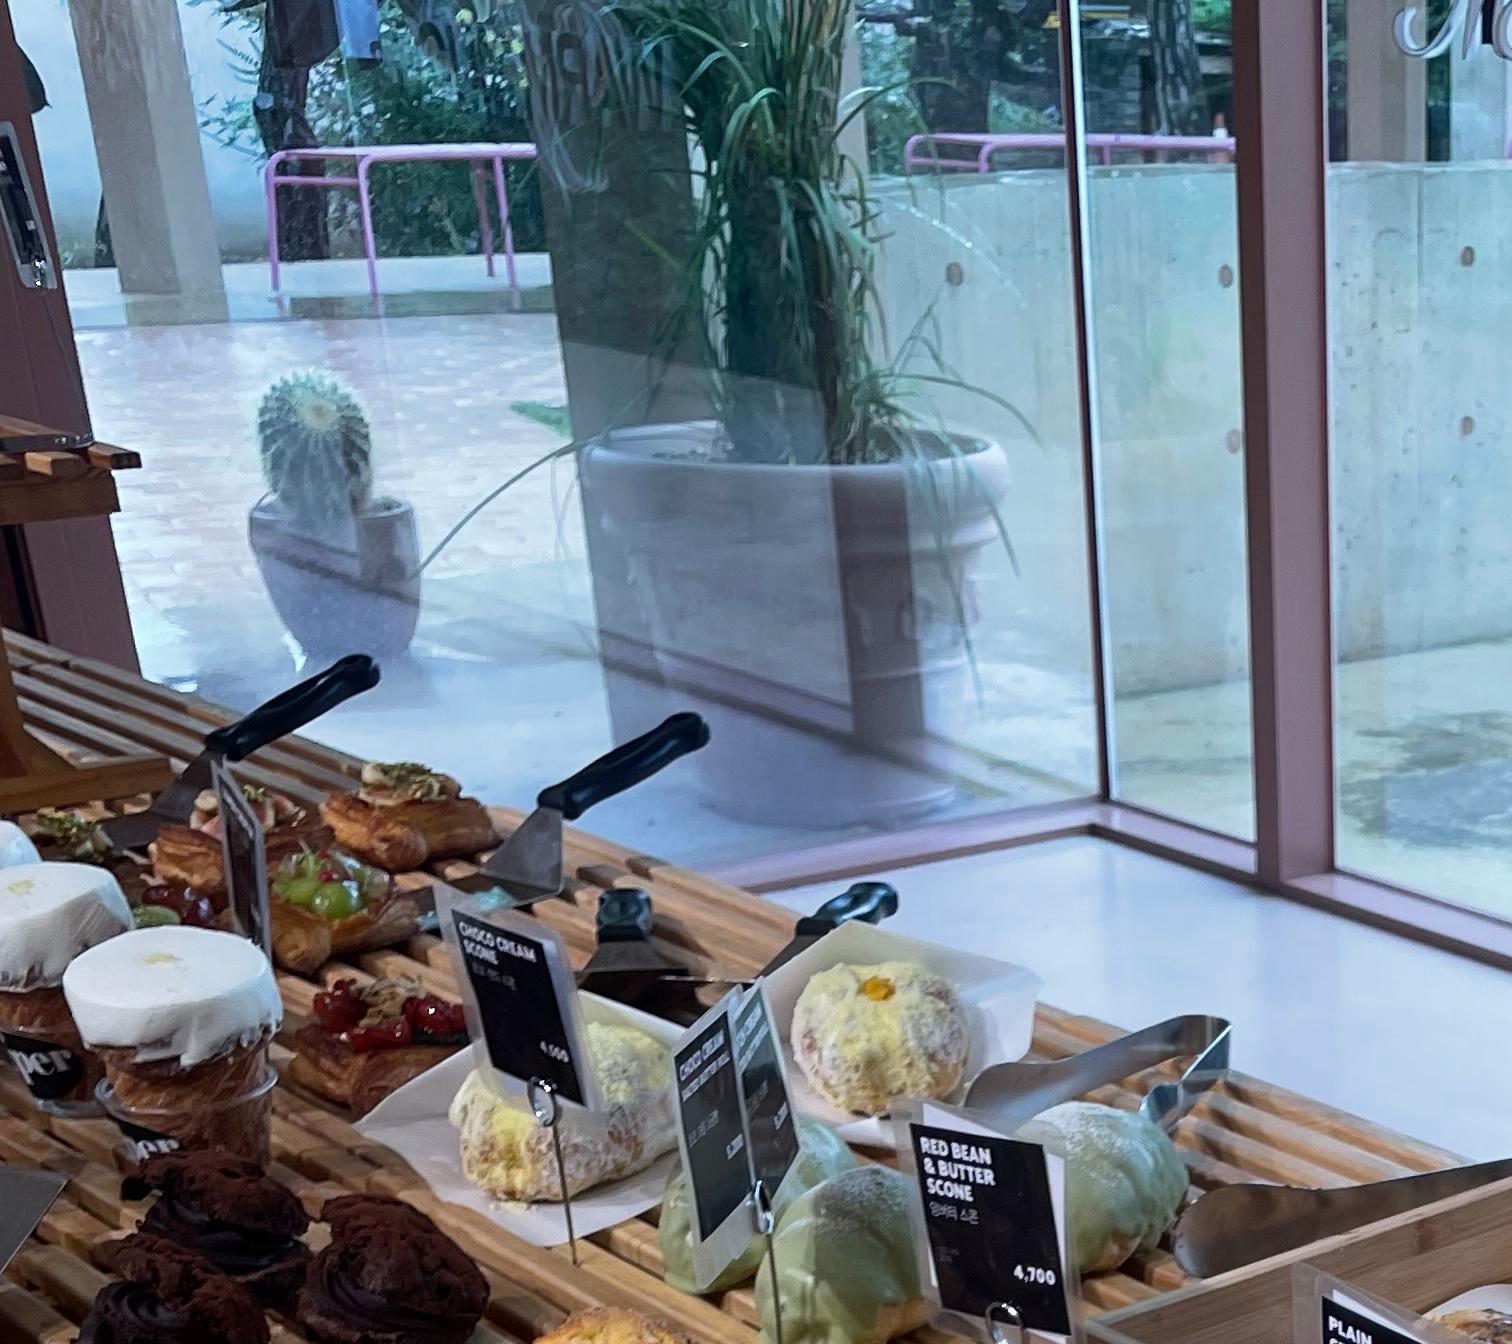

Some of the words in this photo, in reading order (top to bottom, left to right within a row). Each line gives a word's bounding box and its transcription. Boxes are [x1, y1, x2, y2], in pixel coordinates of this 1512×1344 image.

[920, 1136, 949, 1156] RED
[951, 1142, 992, 1165] BEAN
[923, 1157, 936, 1175] &
[937, 1160, 996, 1186] BUTTER
[926, 1177, 974, 1202] SCONE
[1013, 1264, 1056, 1286] 4,700
